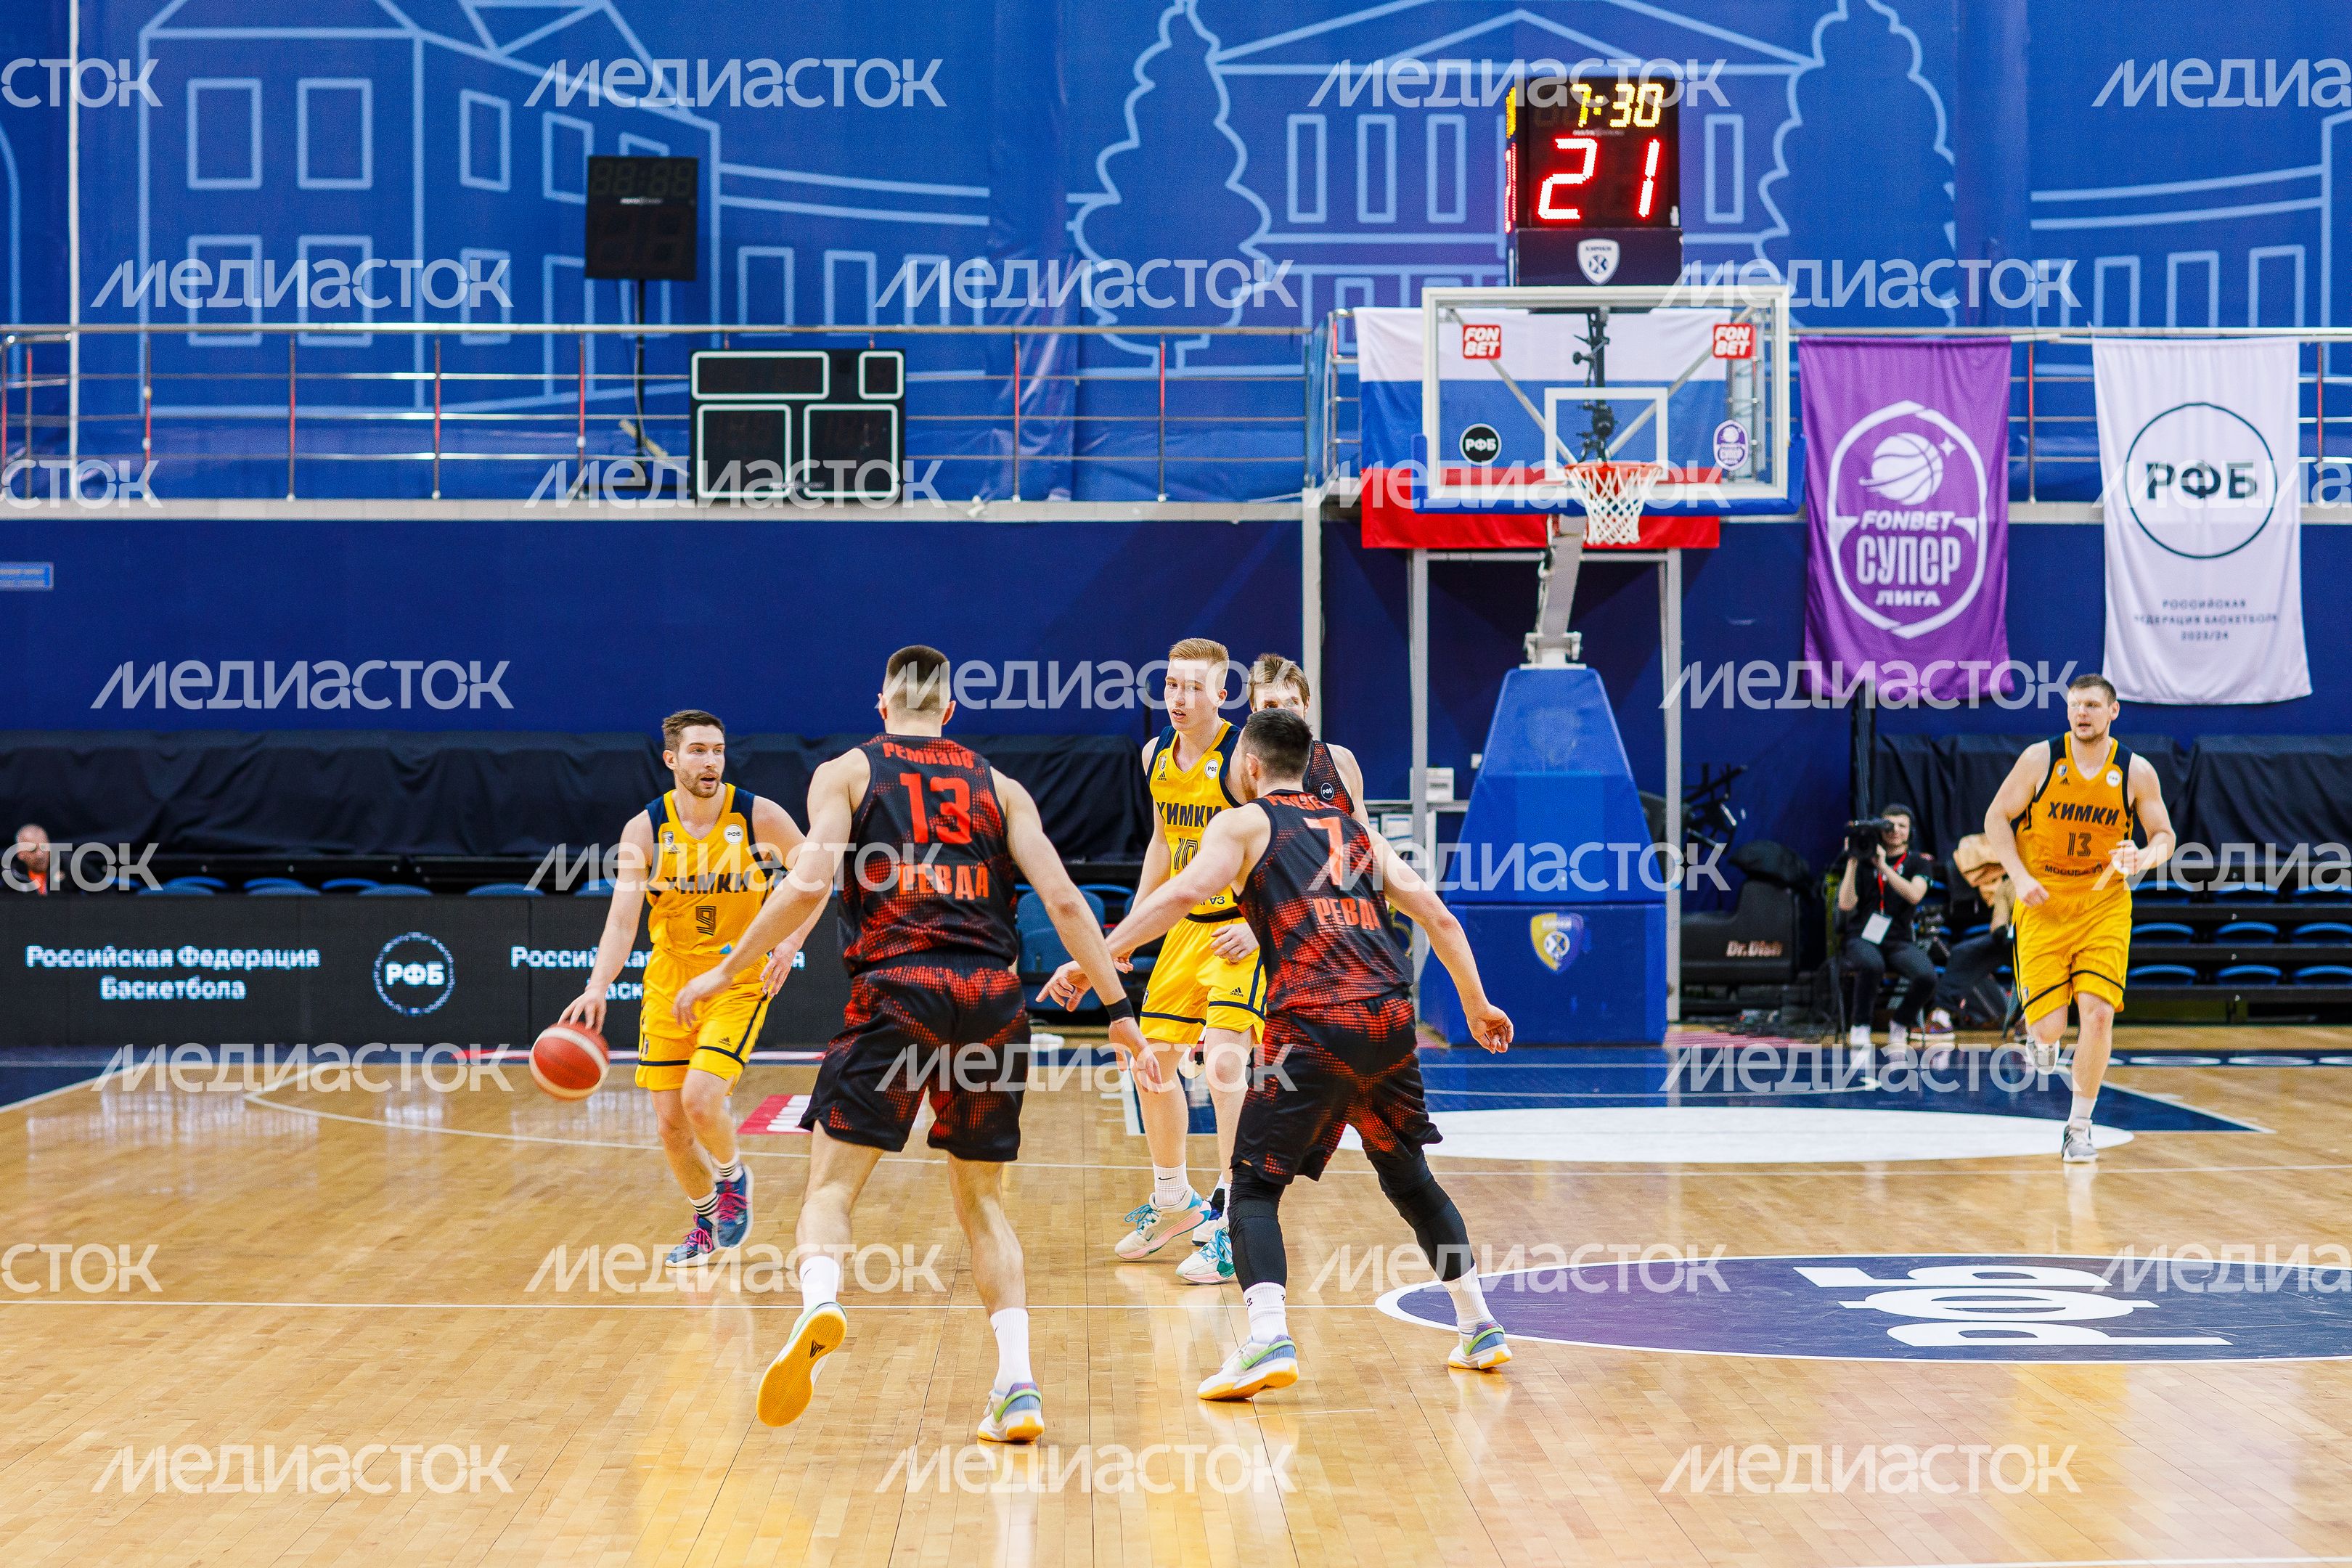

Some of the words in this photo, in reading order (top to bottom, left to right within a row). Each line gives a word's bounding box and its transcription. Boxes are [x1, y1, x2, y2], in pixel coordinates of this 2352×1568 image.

[1571, 83, 1665, 128] 7:30
[1538, 137, 1660, 219] 21
[1464, 327, 1500, 341] FON
[1715, 327, 1750, 341] FON
[1464, 341, 1500, 356] BET
[1714, 340, 1750, 356] BET
[1465, 438, 1497, 452] РФБ
[2147, 460, 2258, 500] РФБ
[1861, 510, 1956, 531] FONBET
[1856, 534, 1961, 587] СУПЕР
[1875, 589, 1942, 607] ЛИГА
[883, 743, 975, 769] РЕМИЗОВ
[899, 772, 973, 844] 13
[1156, 801, 1222, 828] ХИМКИ
[2048, 801, 2120, 826] ХИМКИ
[1174, 838, 1199, 870] 10
[1303, 817, 1343, 886] 7
[2067, 832, 2092, 857] 13
[664, 871, 751, 895] ХИМКИ
[898, 862, 989, 900] РЕВДА
[695, 905, 716, 936] 9
[25, 945, 174, 968] Российская
[176, 945, 321, 971] Федерация
[99, 974, 248, 1000] Баскетбола
[385, 961, 445, 987] РФБ
